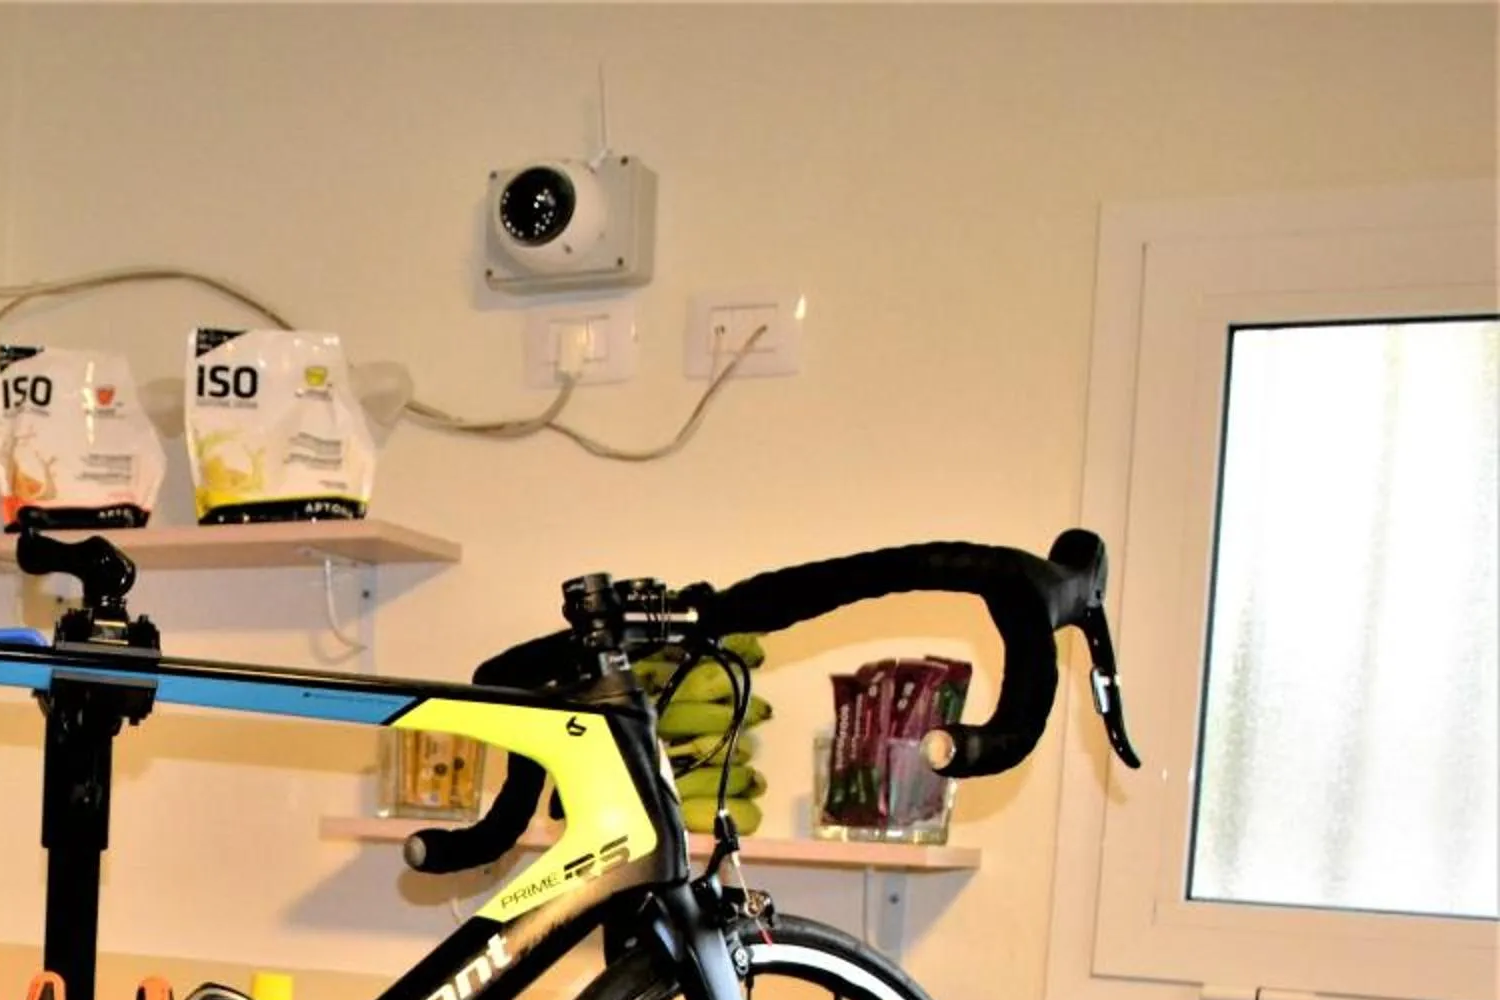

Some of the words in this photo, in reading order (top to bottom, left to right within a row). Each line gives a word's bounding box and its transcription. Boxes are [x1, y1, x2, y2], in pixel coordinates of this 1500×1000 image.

[2, 375, 53, 410] ISO
[196, 364, 258, 398] ISO
[500, 871, 562, 909] PRIME
